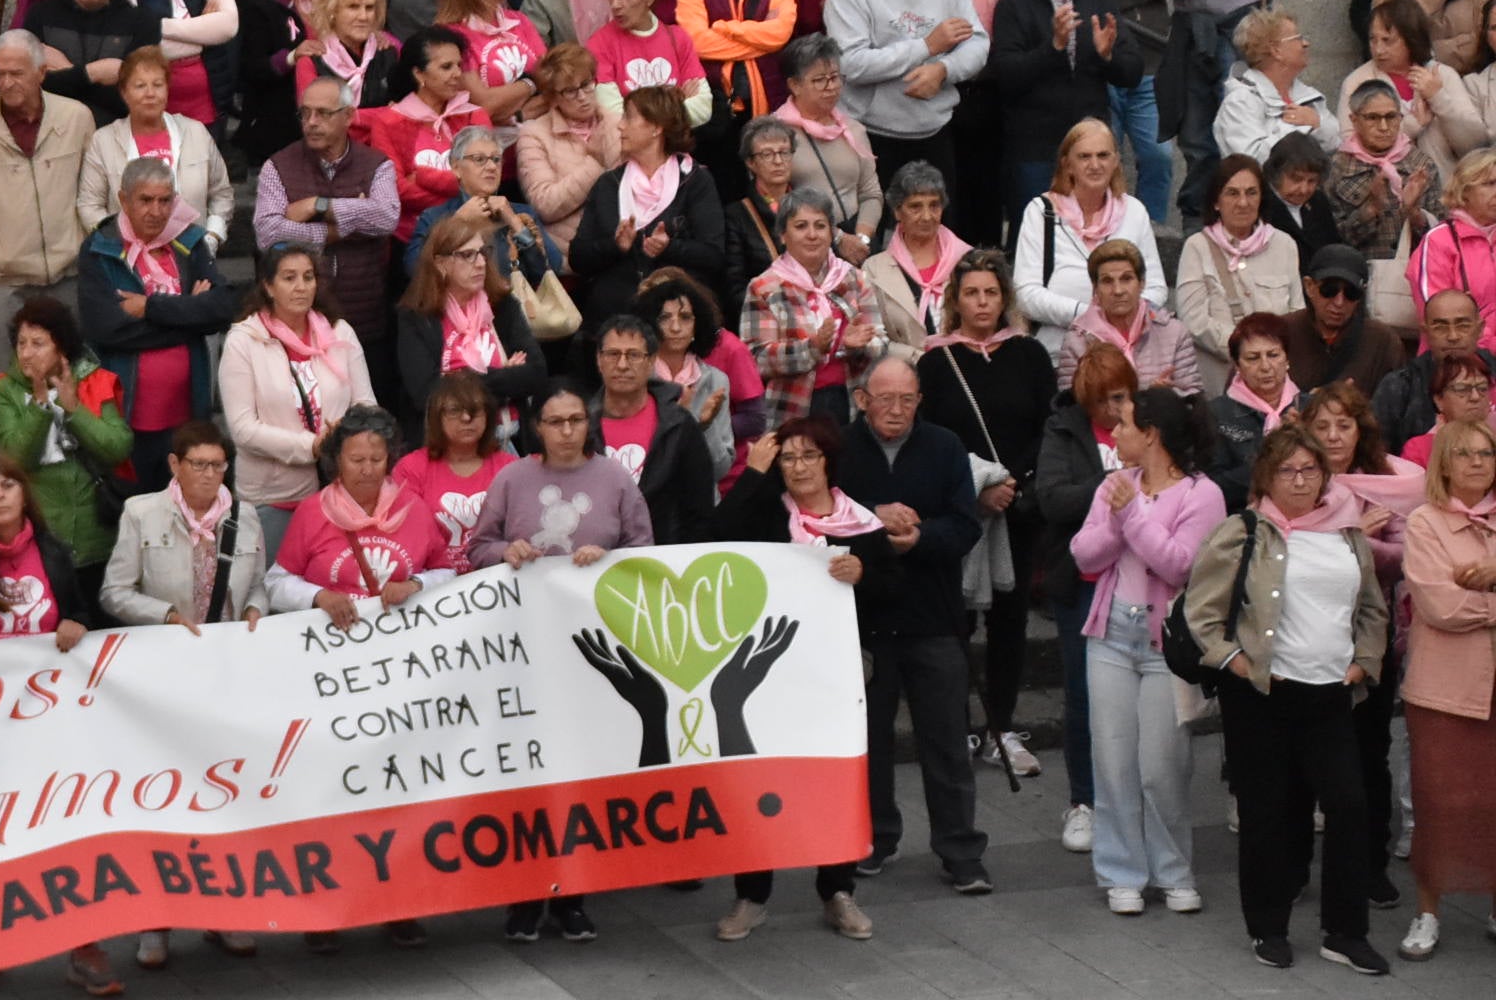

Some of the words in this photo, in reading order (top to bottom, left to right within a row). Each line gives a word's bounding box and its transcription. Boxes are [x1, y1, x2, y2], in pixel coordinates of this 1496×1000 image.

[300, 576, 522, 654] ASOCIACIÓN
[313, 631, 530, 698] BEJARANA
[330, 693, 479, 742] CONTRA
[497, 686, 537, 719] EL
[341, 739, 546, 796] CÁNCER
[151, 838, 341, 899] BÉJAR
[354, 829, 397, 883] Y
[422, 786, 728, 874] COMARCA
